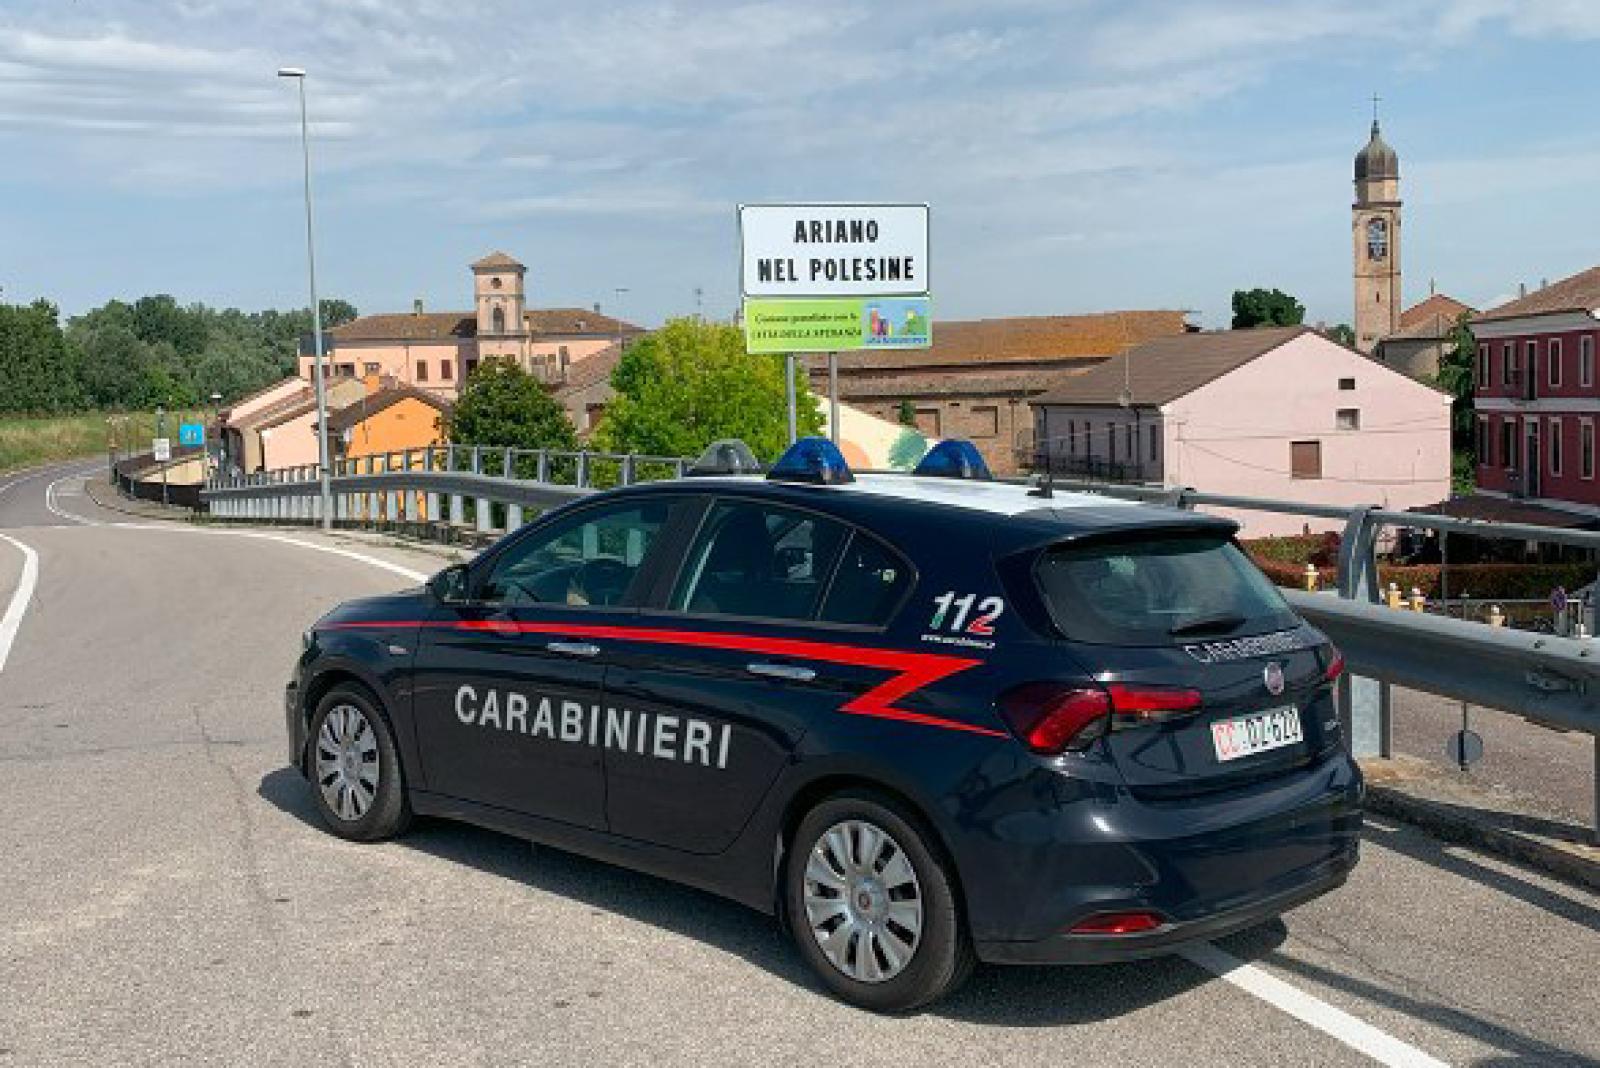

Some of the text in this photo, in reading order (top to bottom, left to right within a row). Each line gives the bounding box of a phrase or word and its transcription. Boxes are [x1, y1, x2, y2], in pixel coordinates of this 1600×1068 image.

[794, 219, 879, 243] ARIANO
[757, 256, 914, 282] NEL POLESINE
[929, 591, 1004, 635] 112
[455, 684, 732, 768] CARABINIERI
